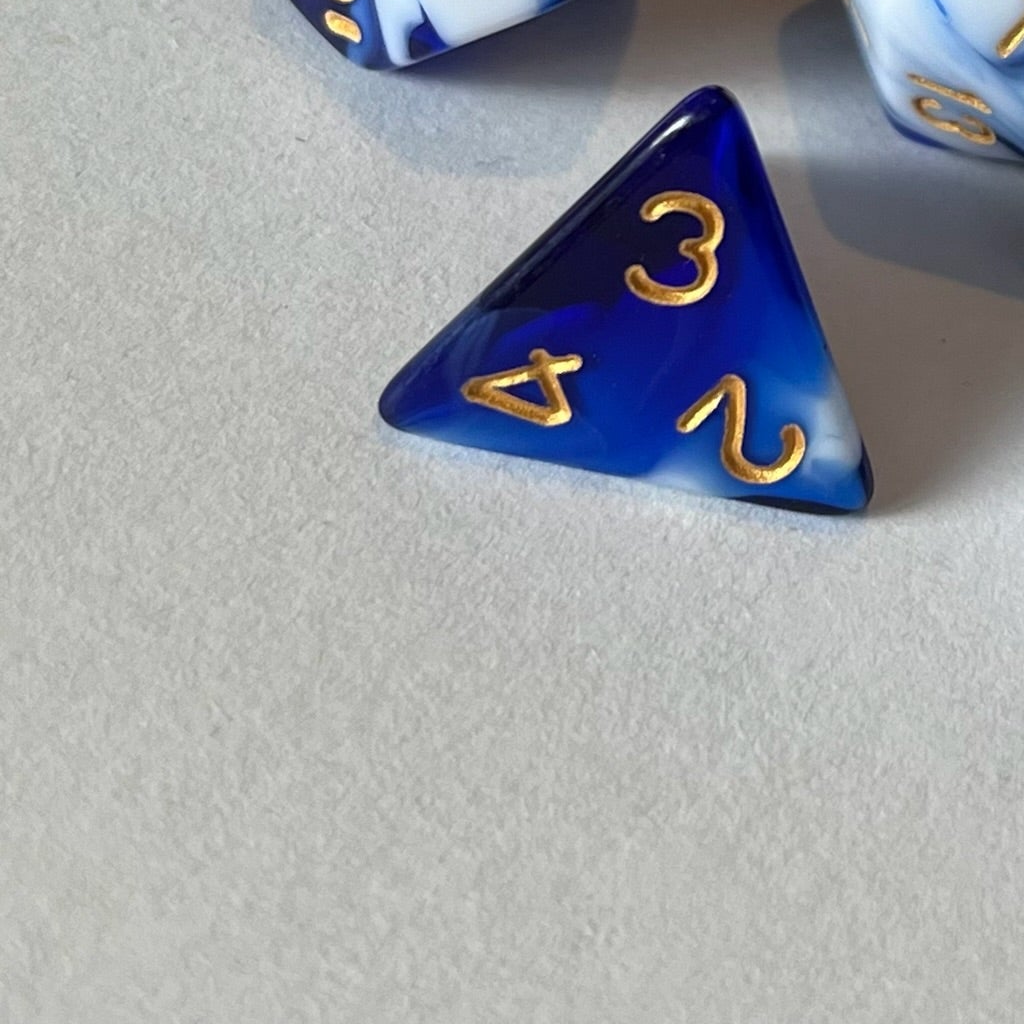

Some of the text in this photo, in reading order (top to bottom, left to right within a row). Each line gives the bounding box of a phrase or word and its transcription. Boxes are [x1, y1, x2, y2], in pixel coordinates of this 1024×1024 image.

[624, 190, 725, 306] 3
[460, 348, 583, 426] 4
[677, 374, 806, 484] 2
